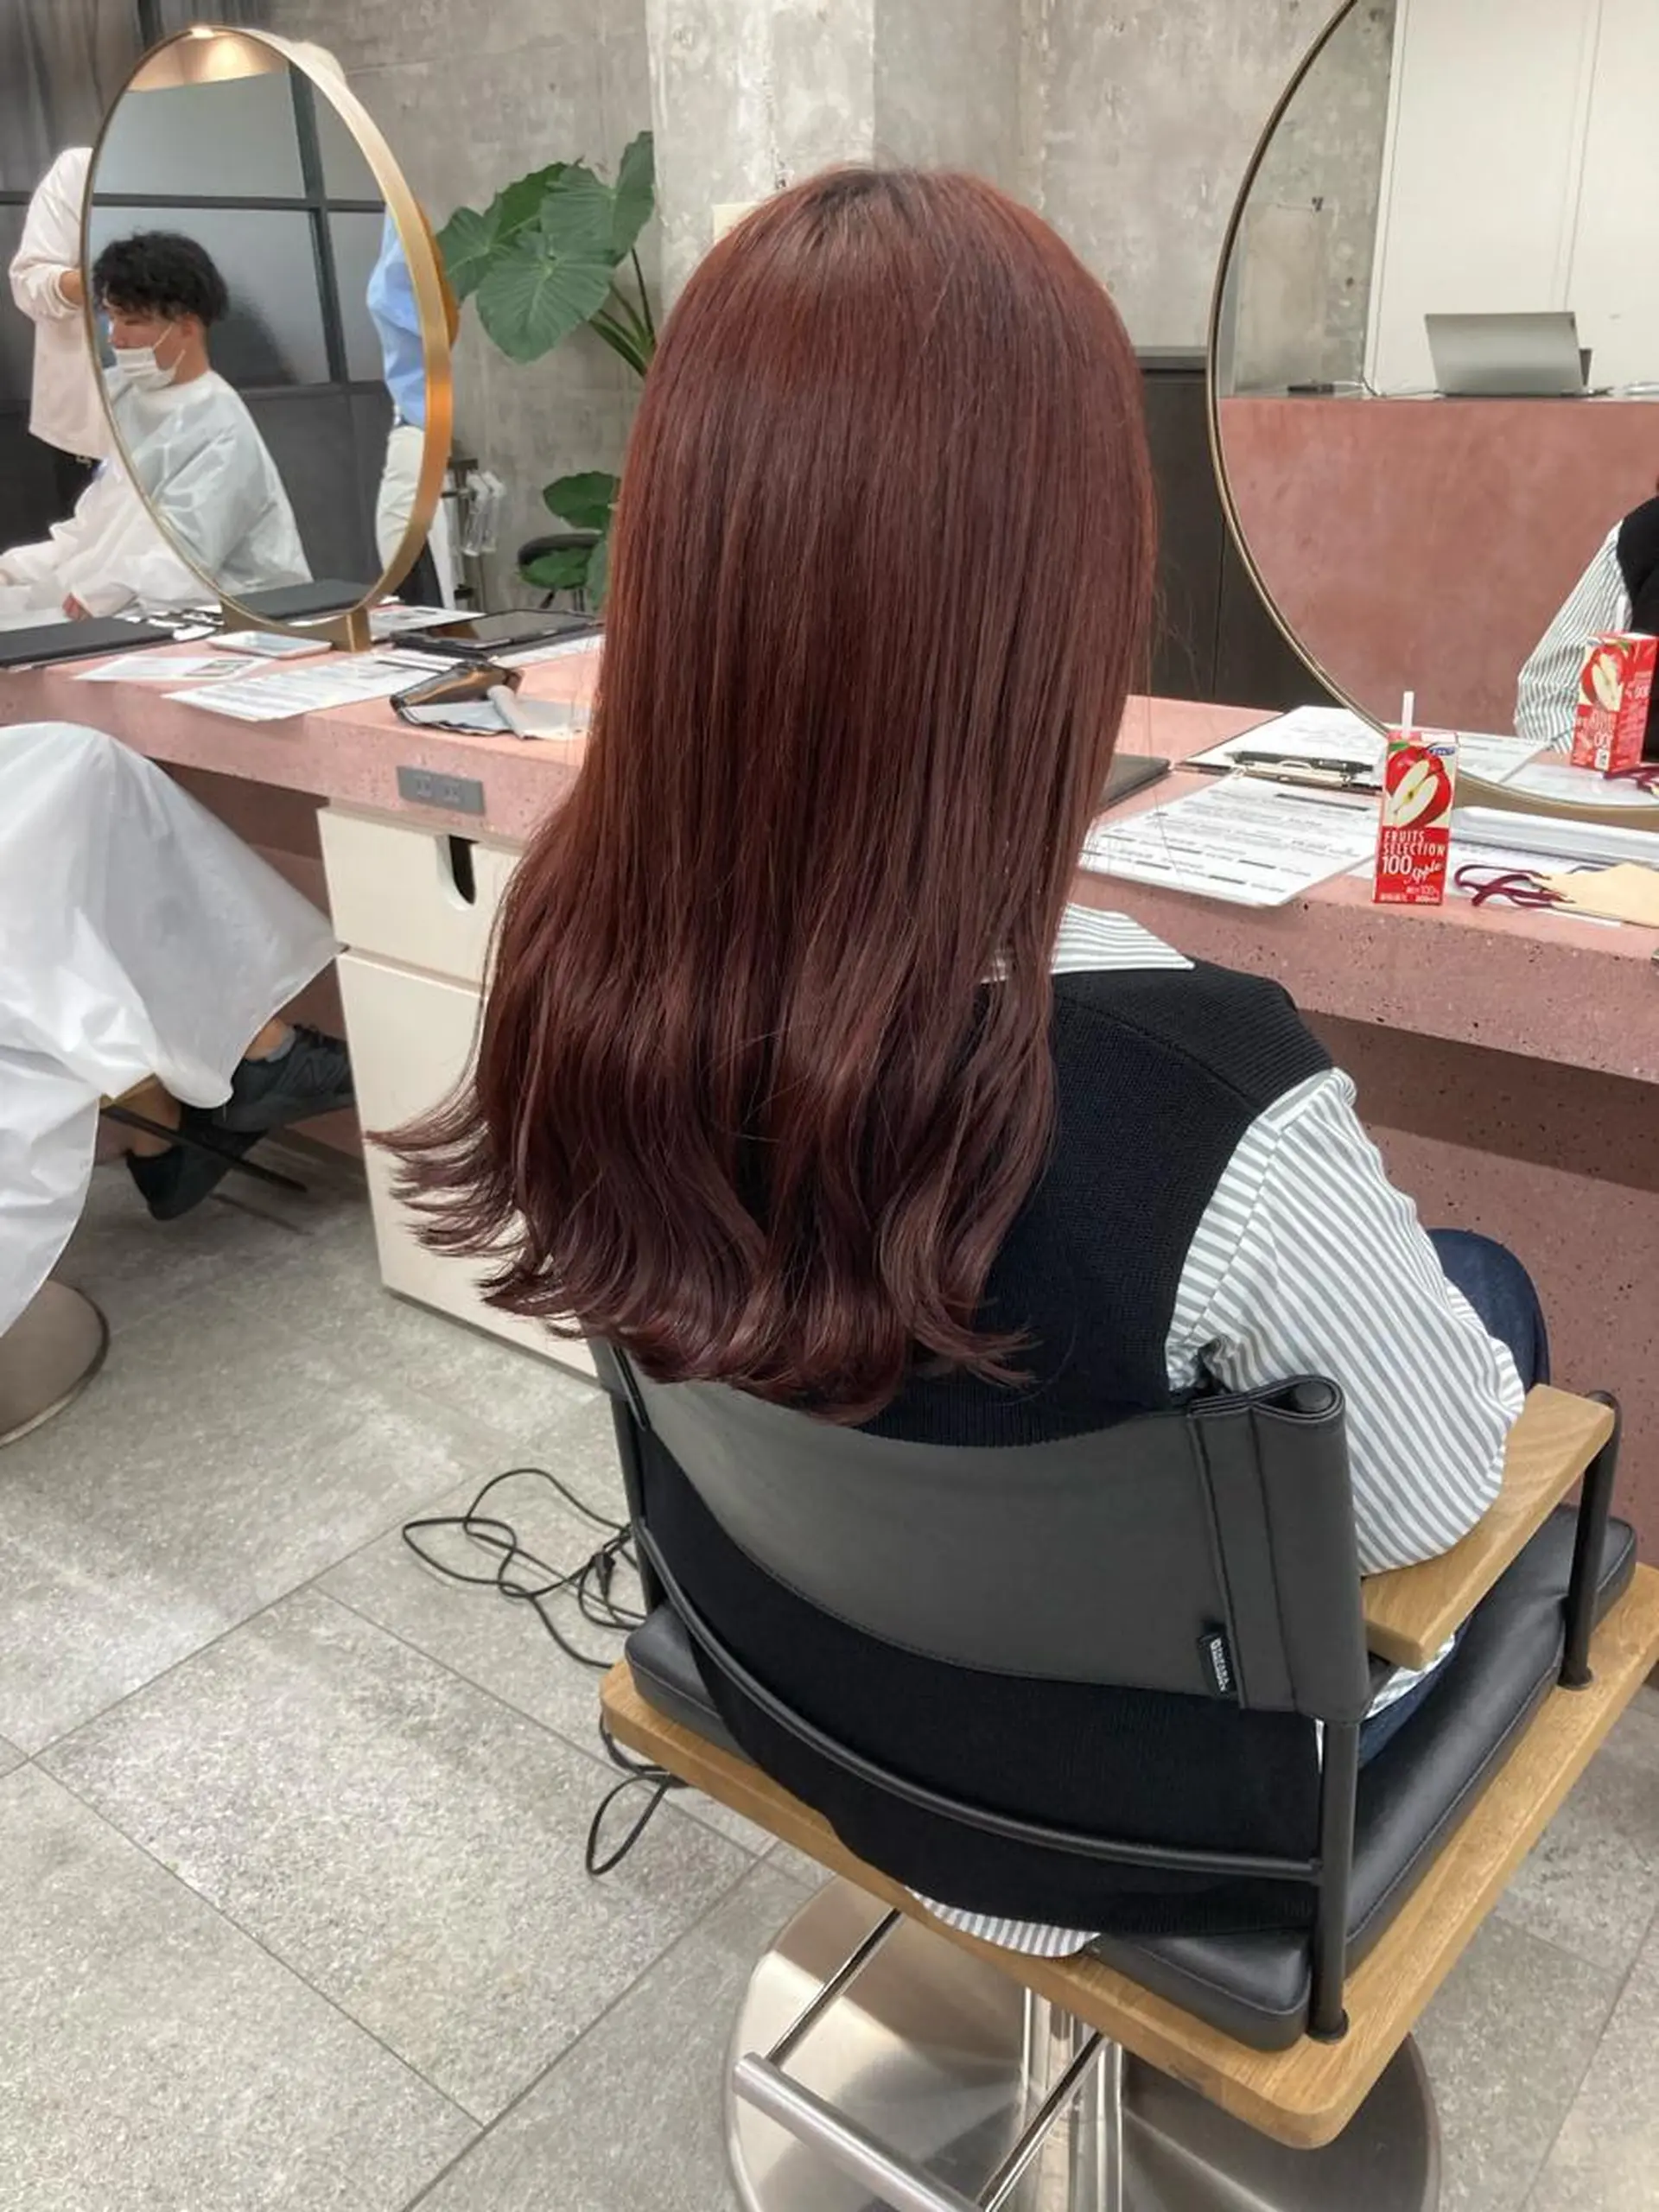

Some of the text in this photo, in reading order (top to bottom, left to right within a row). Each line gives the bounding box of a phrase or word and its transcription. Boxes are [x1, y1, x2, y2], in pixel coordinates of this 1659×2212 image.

[1384, 830, 1425, 842] FRUITS
[1382, 842, 1446, 857] SELECTION
[1382, 855, 1412, 875] 100
